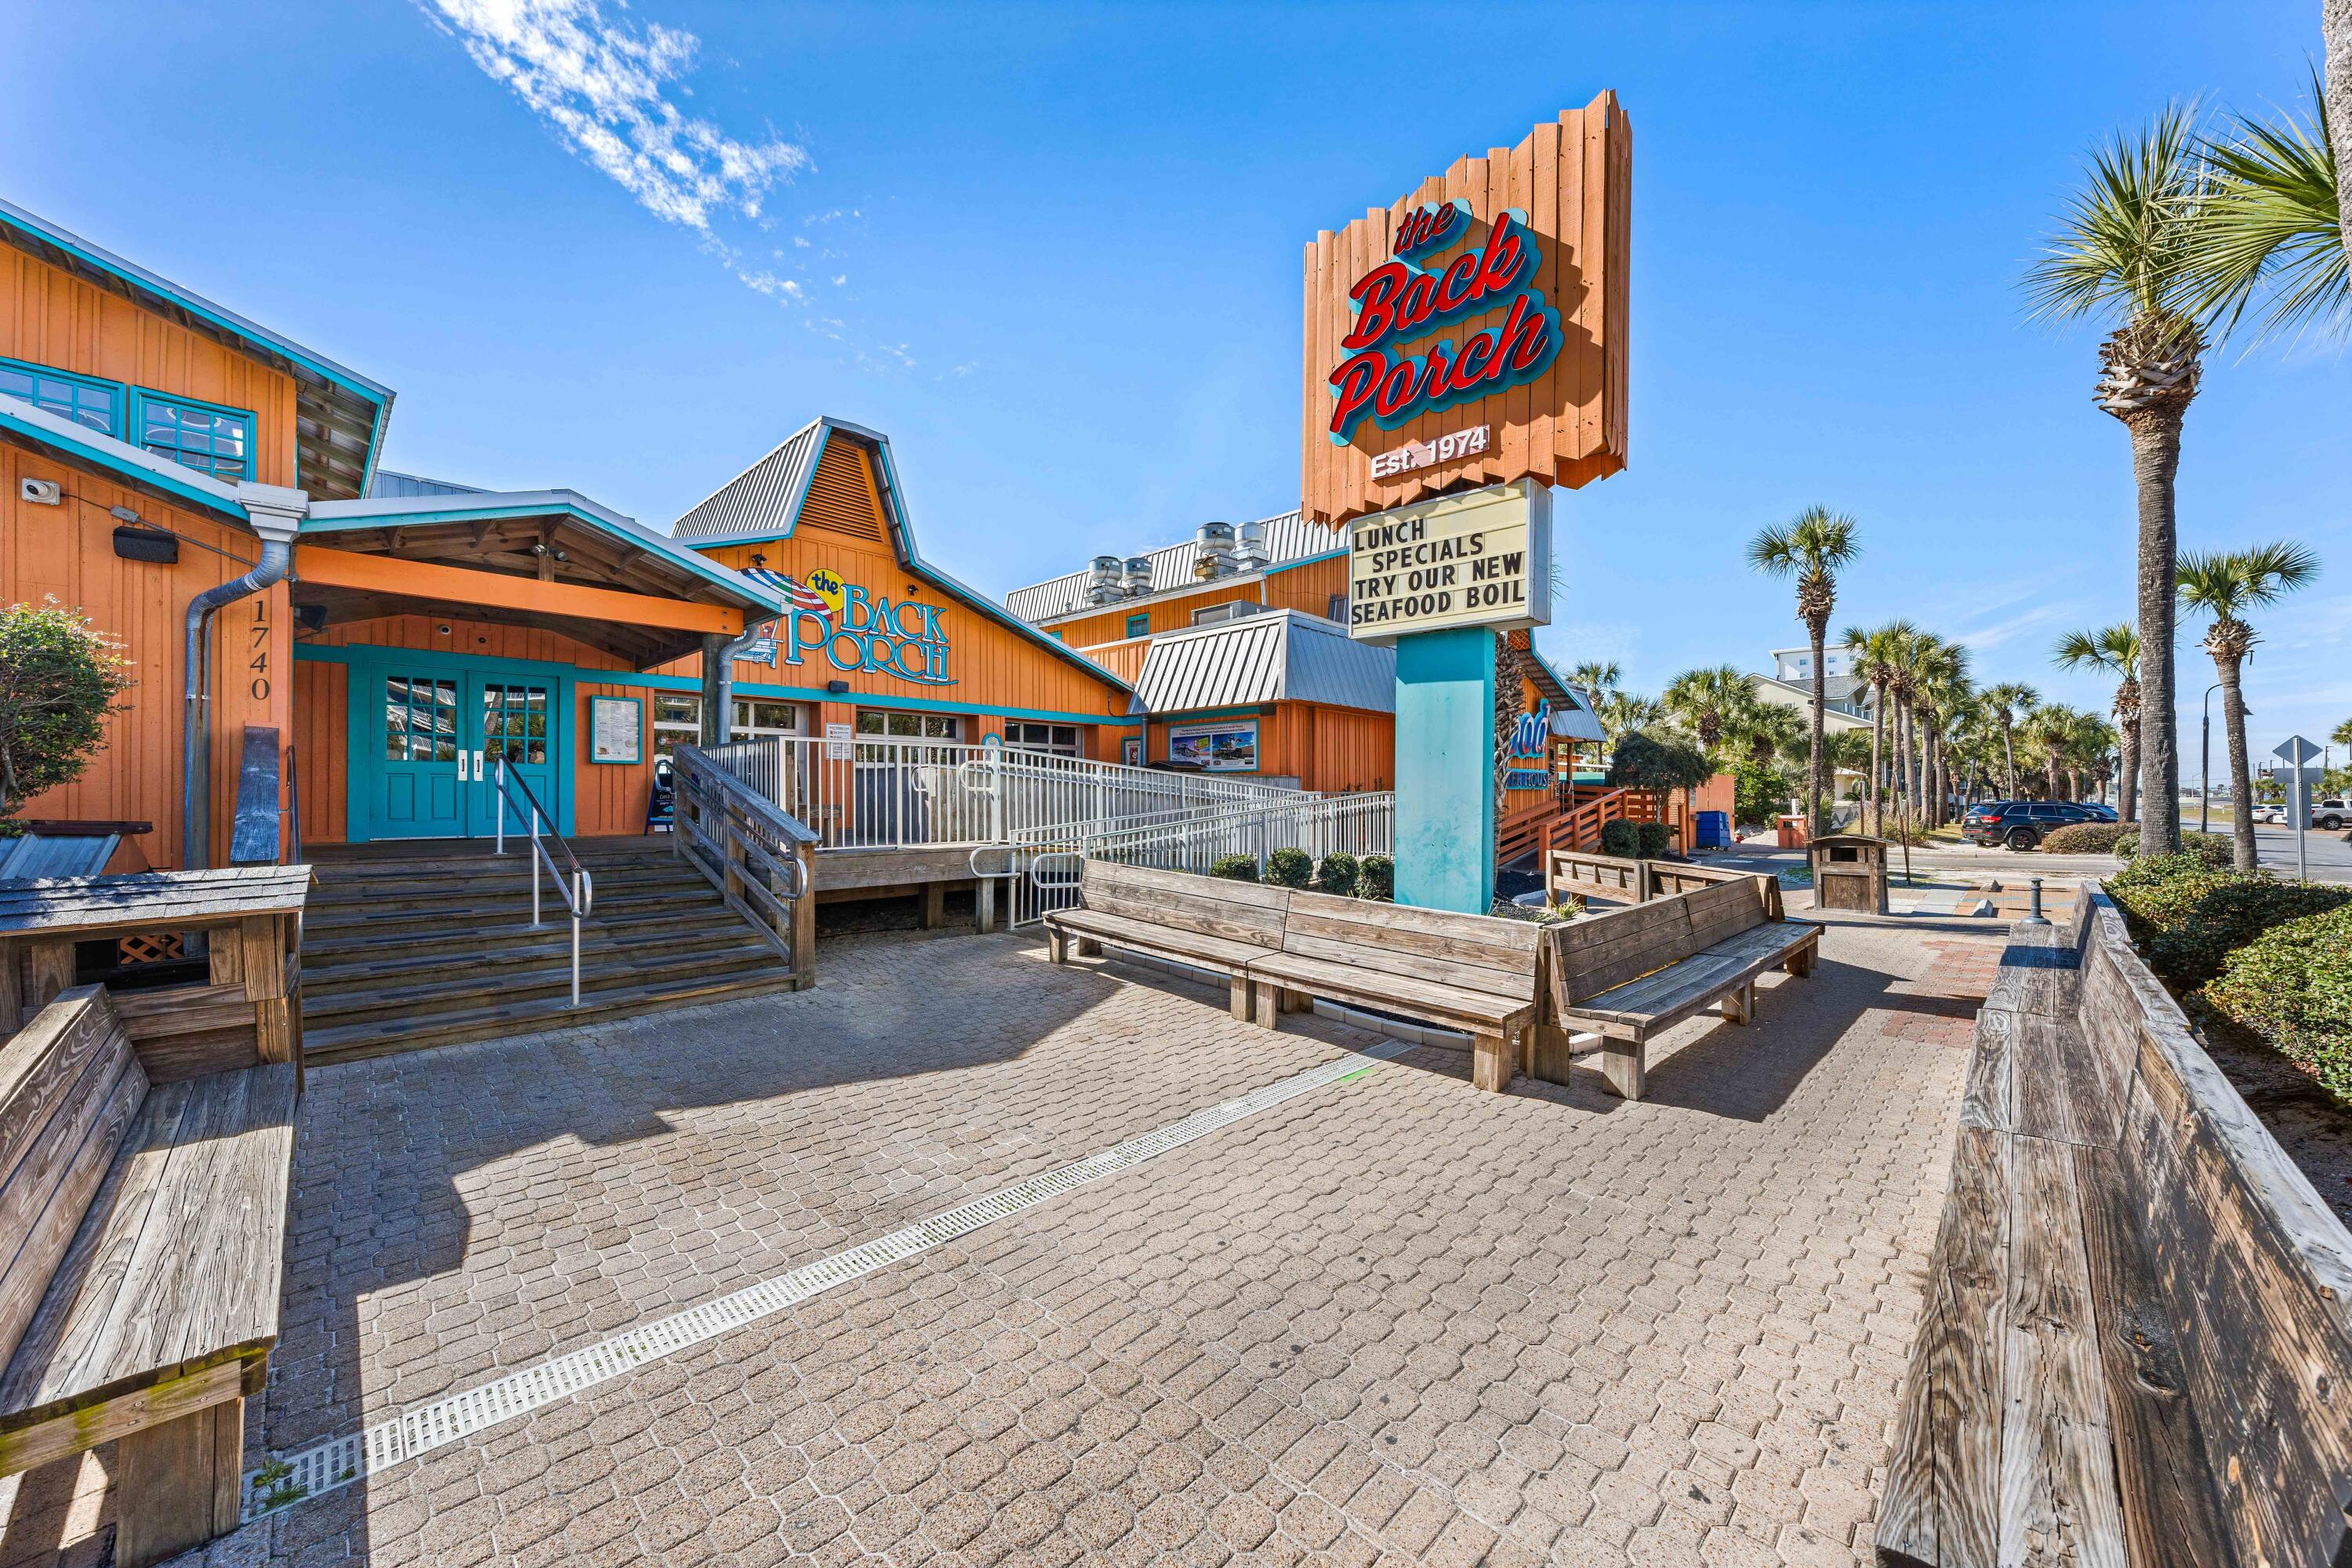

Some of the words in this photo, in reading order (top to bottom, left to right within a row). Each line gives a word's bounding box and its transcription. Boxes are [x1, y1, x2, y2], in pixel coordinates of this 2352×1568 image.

[1392, 201, 1456, 256] the
[1341, 211, 1526, 350] Back
[1328, 293, 1548, 434] Porch
[1370, 452, 1417, 480] Est.
[1427, 426, 1487, 464] 1974
[1355, 518, 1424, 552] LUNCH
[1373, 532, 1483, 573] SPECIALS
[811, 571, 839, 596] the
[1352, 591, 1451, 625] SEAFOOD
[1466, 579, 1525, 608] BOIL
[1355, 575, 1396, 600] TRY
[1408, 564, 1456, 591] OUR
[1472, 552, 1523, 582] NEW
[840, 583, 949, 644] BACK
[249, 600, 270, 700] 1740
[785, 607, 959, 685] PORCH
[1525, 772, 1552, 787] HOUSE
